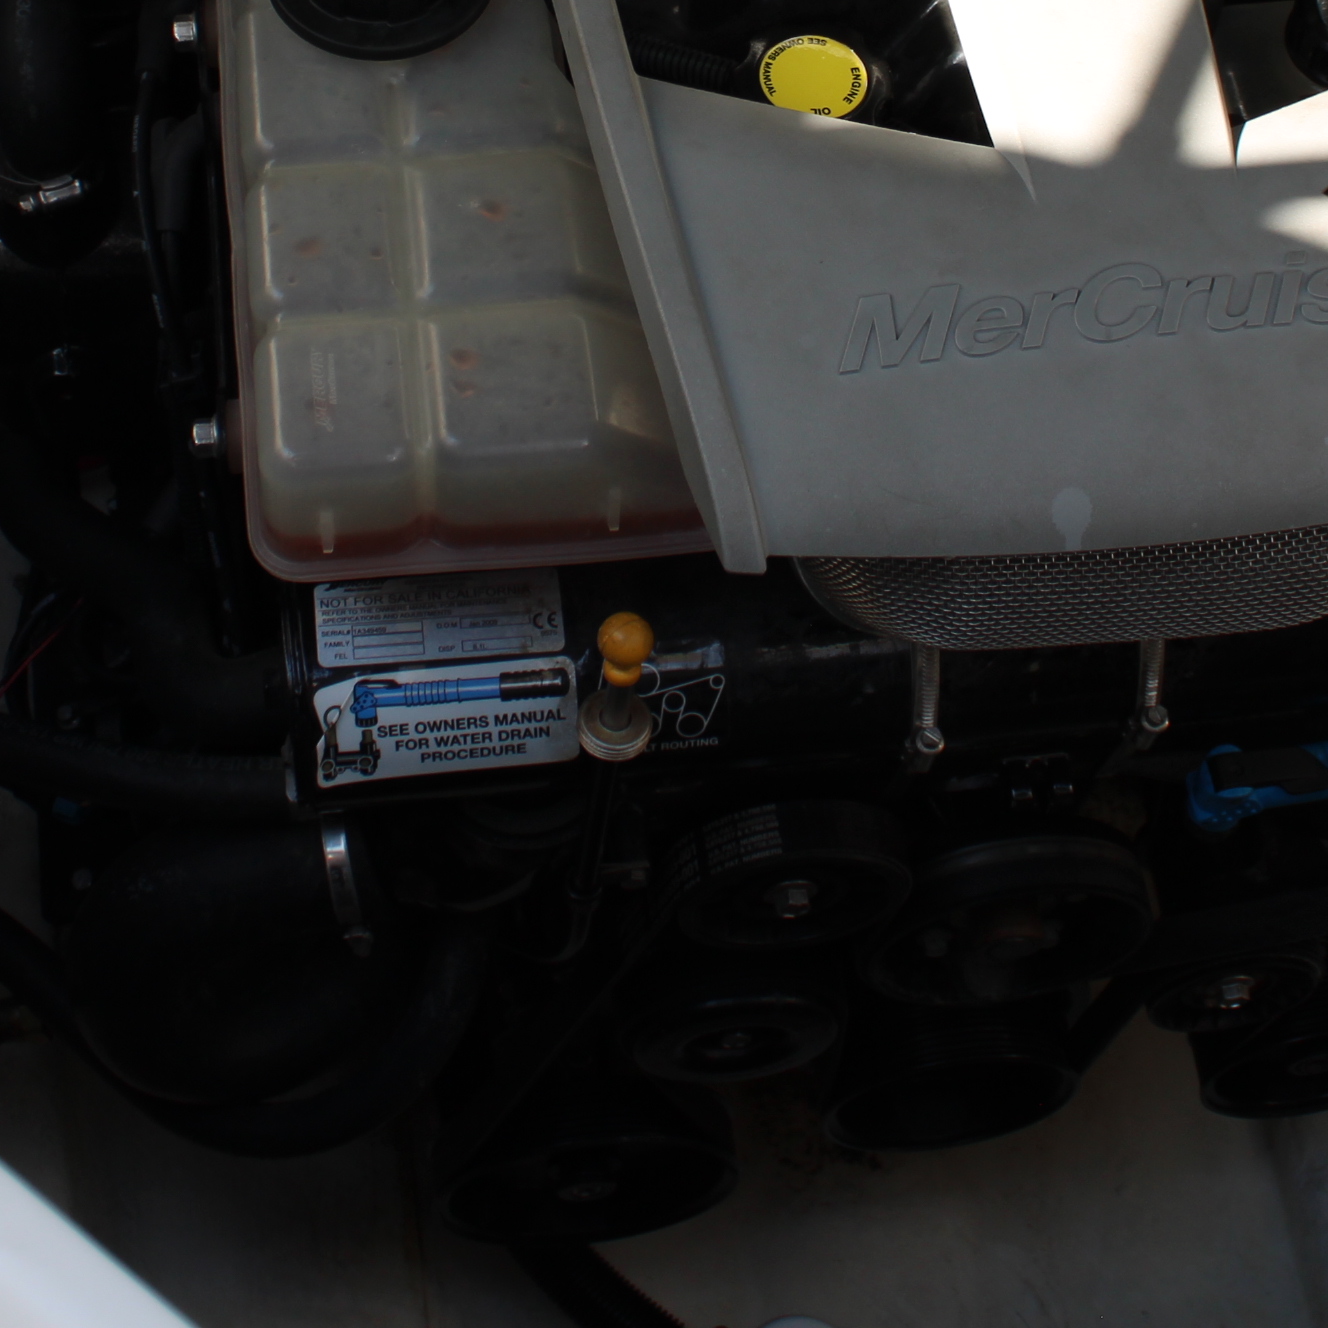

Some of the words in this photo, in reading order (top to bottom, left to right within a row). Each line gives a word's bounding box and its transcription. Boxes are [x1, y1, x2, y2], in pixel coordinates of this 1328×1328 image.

[767, 38, 804, 62] OWNERS
[807, 37, 827, 47] SEE
[762, 61, 777, 97] MANUAL
[843, 67, 862, 105] ENGINE
[810, 107, 832, 116] OIL
[319, 598, 349, 610] NOT
[354, 594, 384, 606] FOR
[388, 591, 423, 604] SALE
[427, 589, 443, 601] IN
[445, 584, 532, 601] CALIFORNIA
[533, 611, 559, 630] CE
[323, 640, 350, 648] FAMILY
[334, 652, 349, 661] FEL
[377, 724, 410, 738] SEE
[415, 715, 490, 734] OWNERS
[494, 708, 567, 726] MANUAL
[395, 738, 431, 752] FOR
[434, 732, 493, 749] WATER
[497, 726, 552, 742] DRAIN
[660, 736, 720, 752] ROUTING
[420, 743, 528, 764] PROCEDURE
